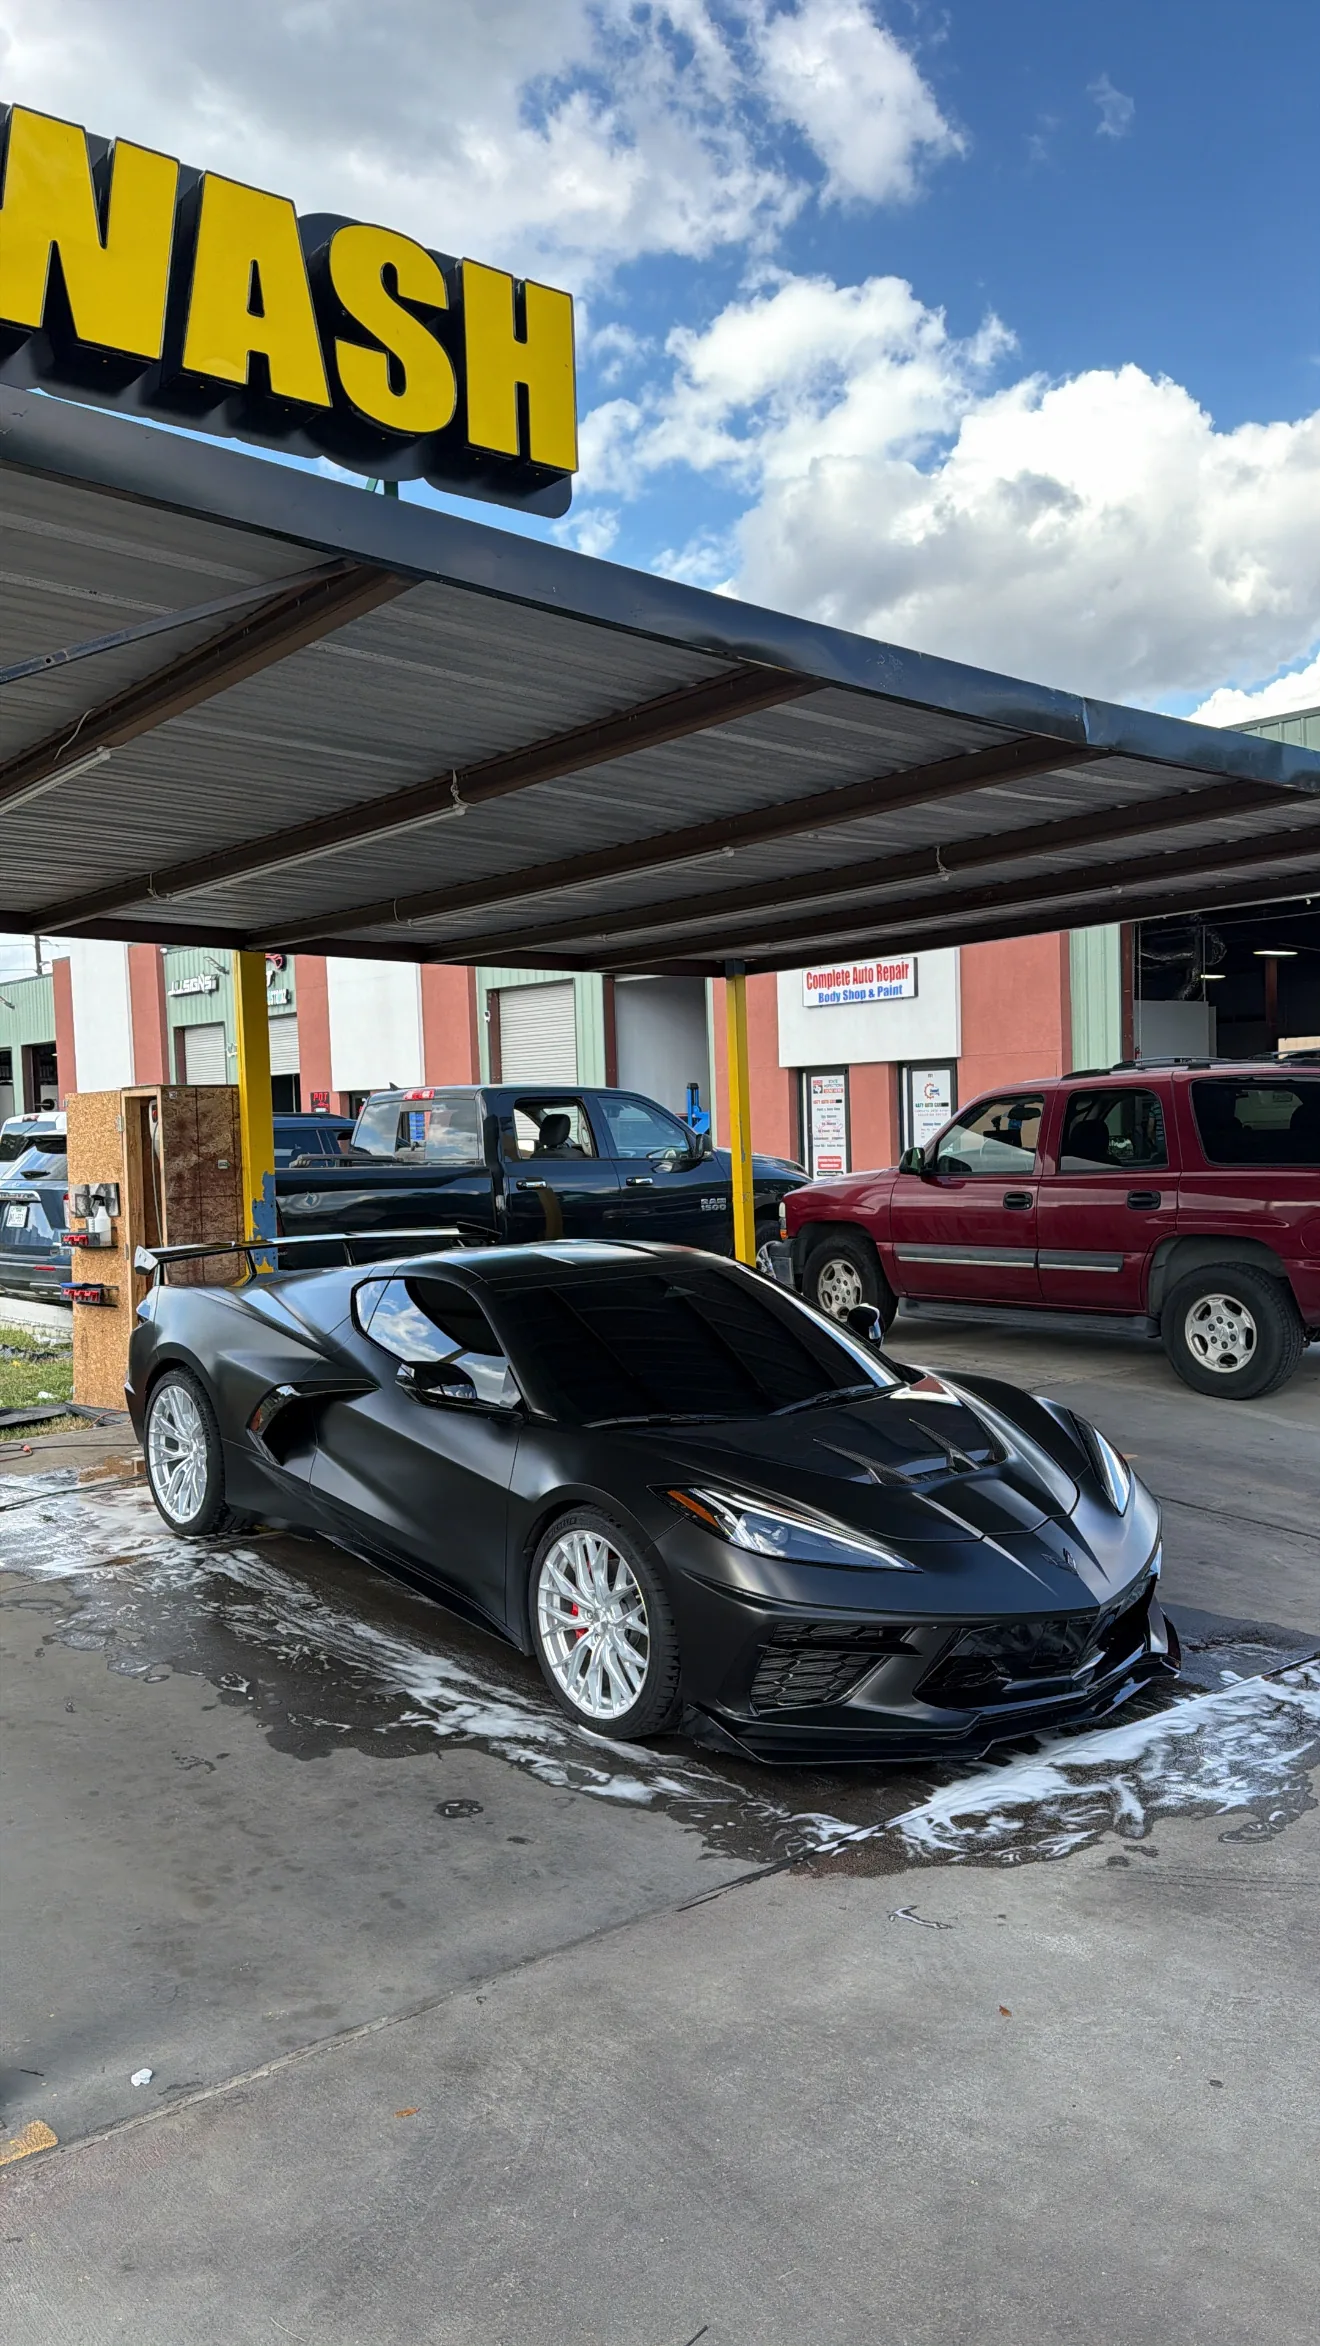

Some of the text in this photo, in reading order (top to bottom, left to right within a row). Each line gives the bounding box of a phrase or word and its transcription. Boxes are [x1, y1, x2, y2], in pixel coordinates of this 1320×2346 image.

[806, 961, 909, 990] Complete Auto Repair
[818, 984, 902, 1003] Body Shop & Paint
